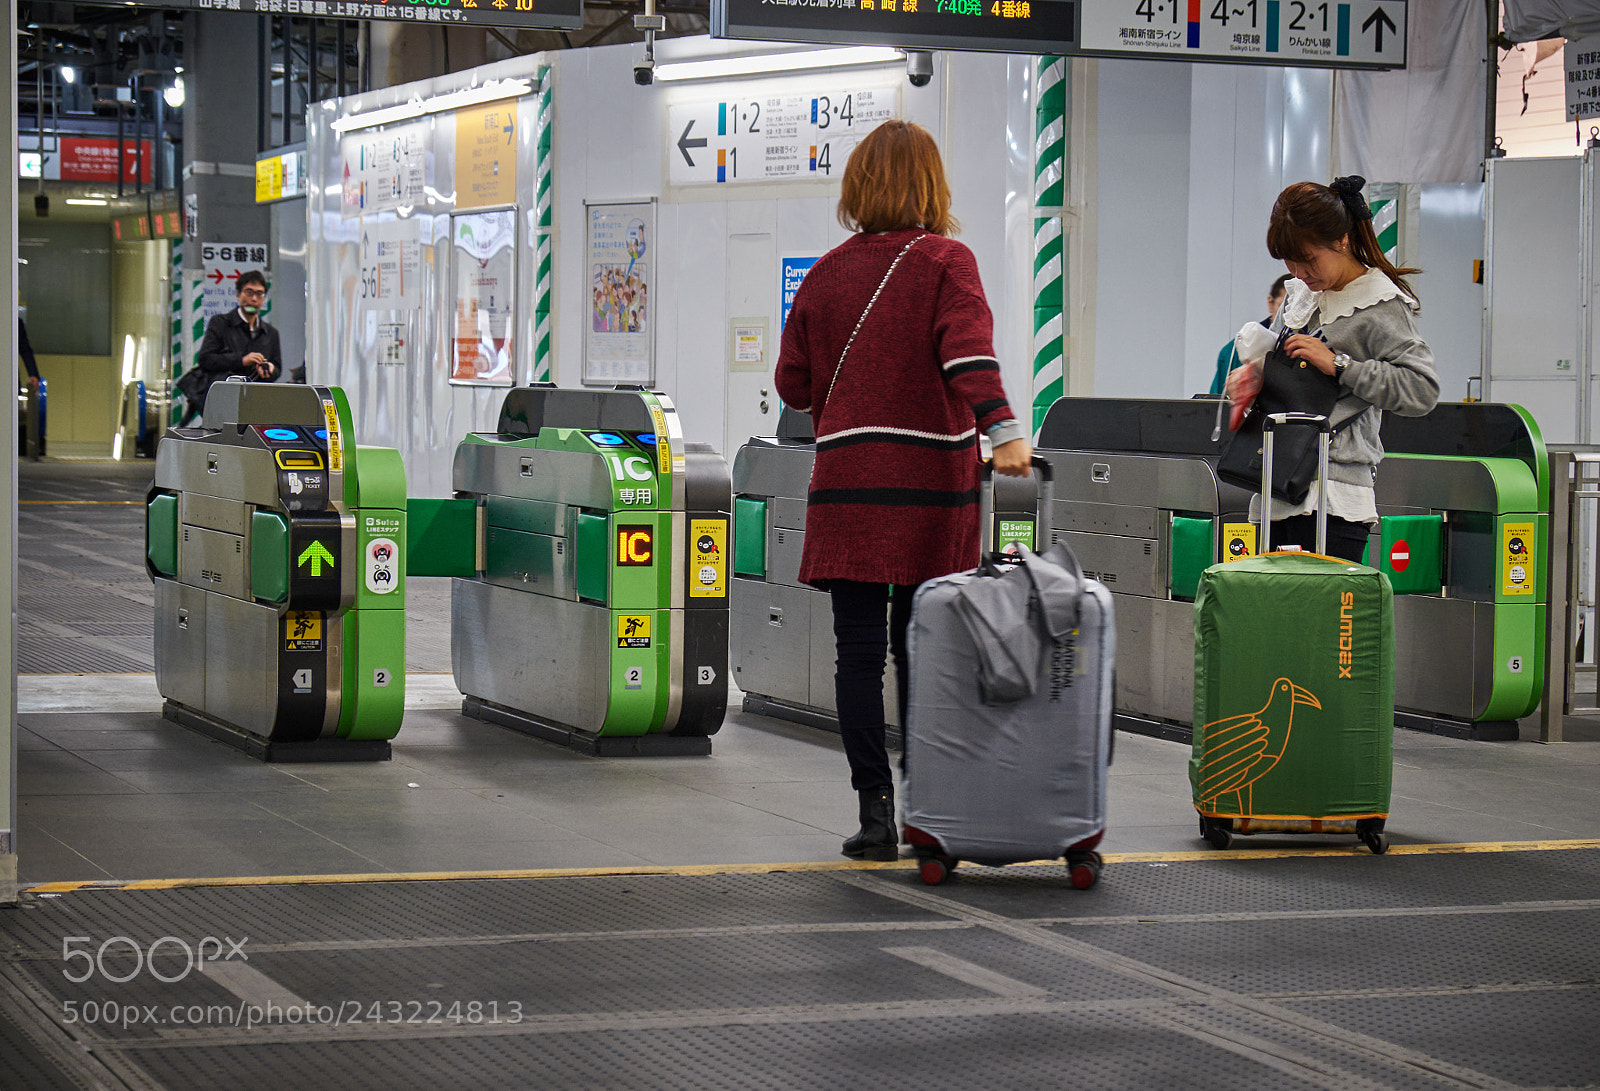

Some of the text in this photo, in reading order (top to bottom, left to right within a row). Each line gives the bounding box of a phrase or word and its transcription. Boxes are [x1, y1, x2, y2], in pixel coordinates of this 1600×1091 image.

[990, 1, 1031, 19] 4番線
[1119, 27, 1182, 40] 湘南新宿ライン
[1233, 33, 1261, 45] 埼京線
[1289, 36, 1331, 48] りんかい線
[203, 246, 265, 263] 5・6番線
[610, 456, 653, 481] IC
[619, 488, 652, 505] 専用
[619, 532, 651, 562] IC
[1339, 592, 1354, 679] SUMDEX
[1063, 639, 1076, 688] NATIONAL
[1512, 660, 1520, 670] 5
[301, 673, 306, 684] 1
[377, 672, 385, 683] 2
[630, 670, 639, 681] 2
[701, 670, 709, 681] 3
